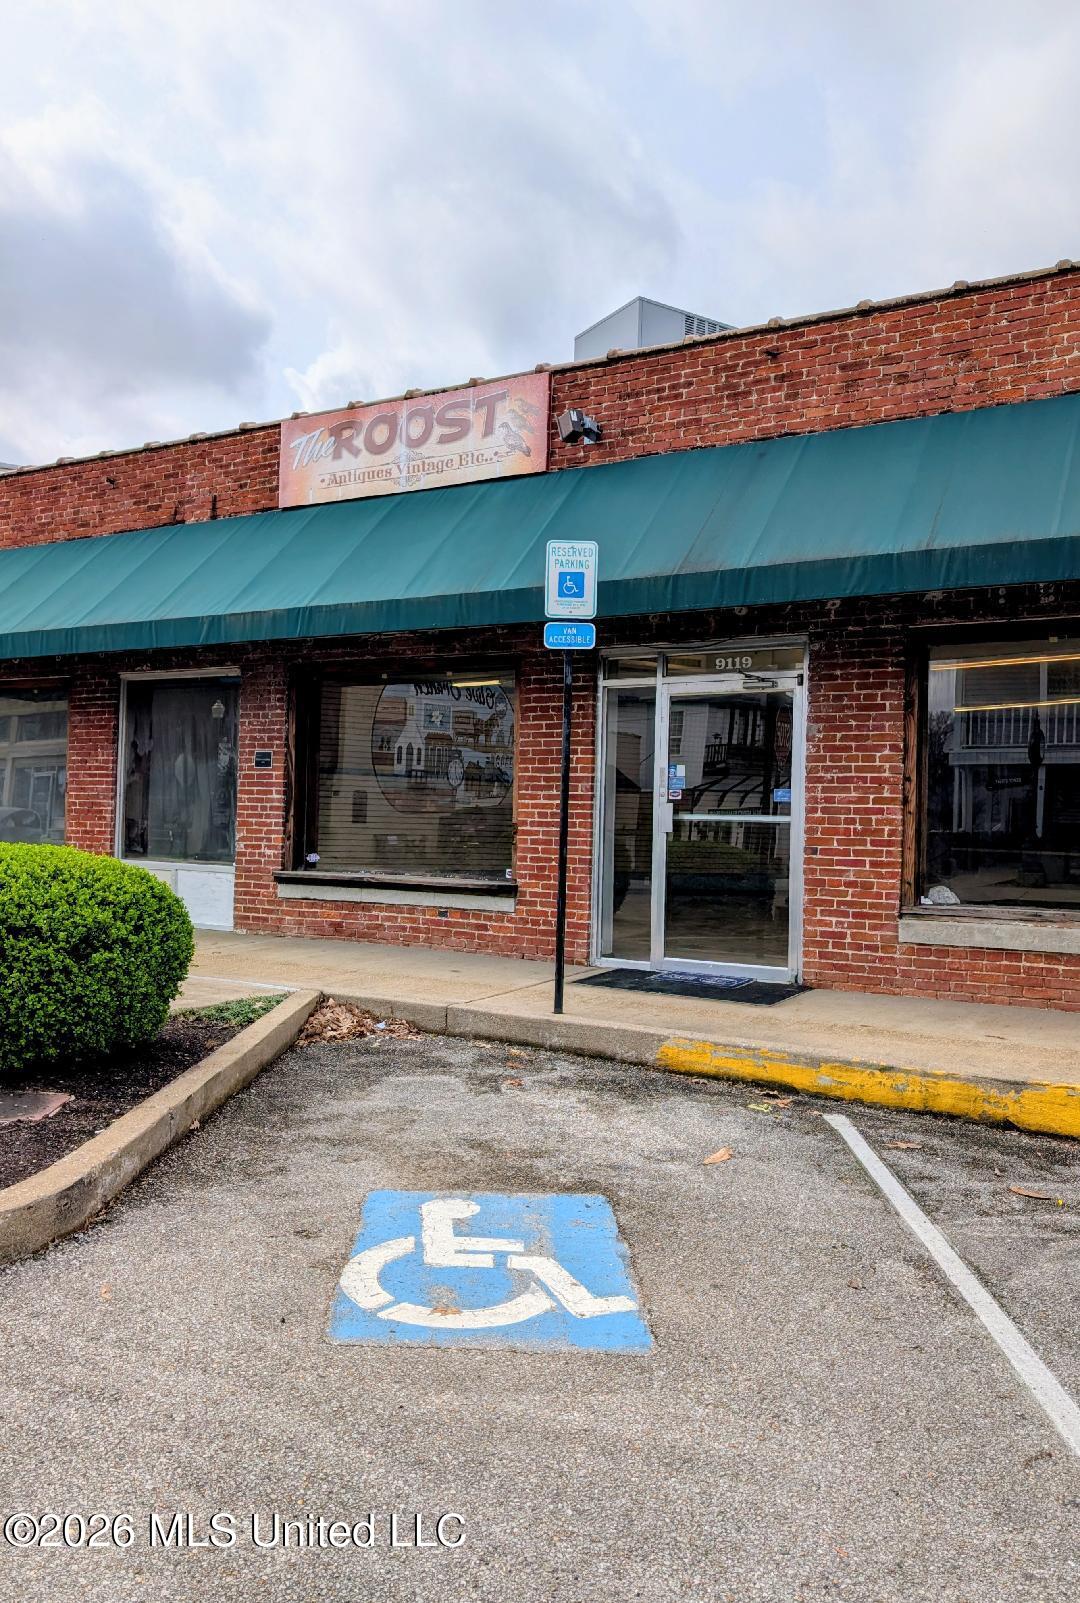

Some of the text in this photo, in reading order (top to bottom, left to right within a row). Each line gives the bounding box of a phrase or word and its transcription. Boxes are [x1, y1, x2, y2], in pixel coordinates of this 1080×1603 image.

[290, 389, 508, 470] The ROOST
[328, 468, 392, 486] Antiques
[397, 457, 454, 474] Vintage
[551, 547, 593, 557] RESERVED
[554, 559, 590, 569] PARKING
[563, 627, 577, 635] VAN
[549, 635, 592, 644] ACCESSIBLE
[715, 656, 752, 670] 9119
